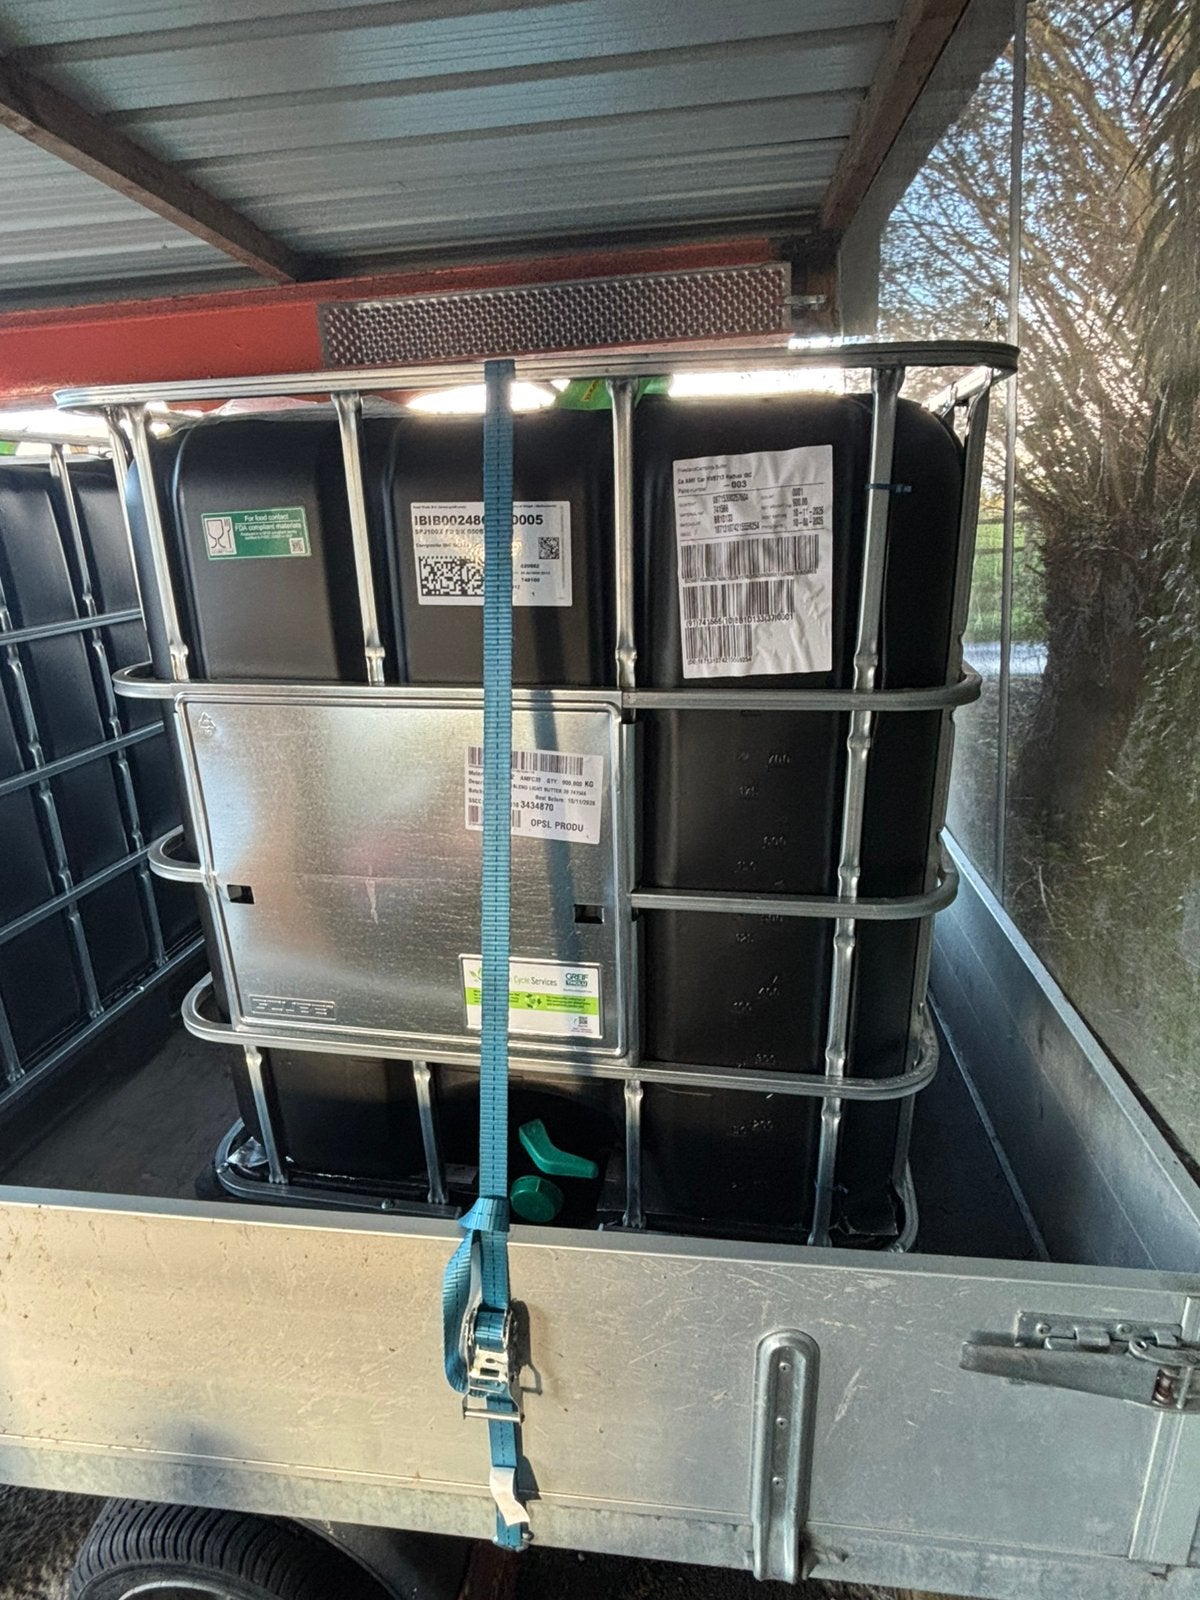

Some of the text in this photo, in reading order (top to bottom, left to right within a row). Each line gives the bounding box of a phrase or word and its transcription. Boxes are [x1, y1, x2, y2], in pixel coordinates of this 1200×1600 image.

[520, 800, 554, 811] 3434870
[531, 818, 584, 832] OPSL PRODU
[531, 977, 558, 987] Services
